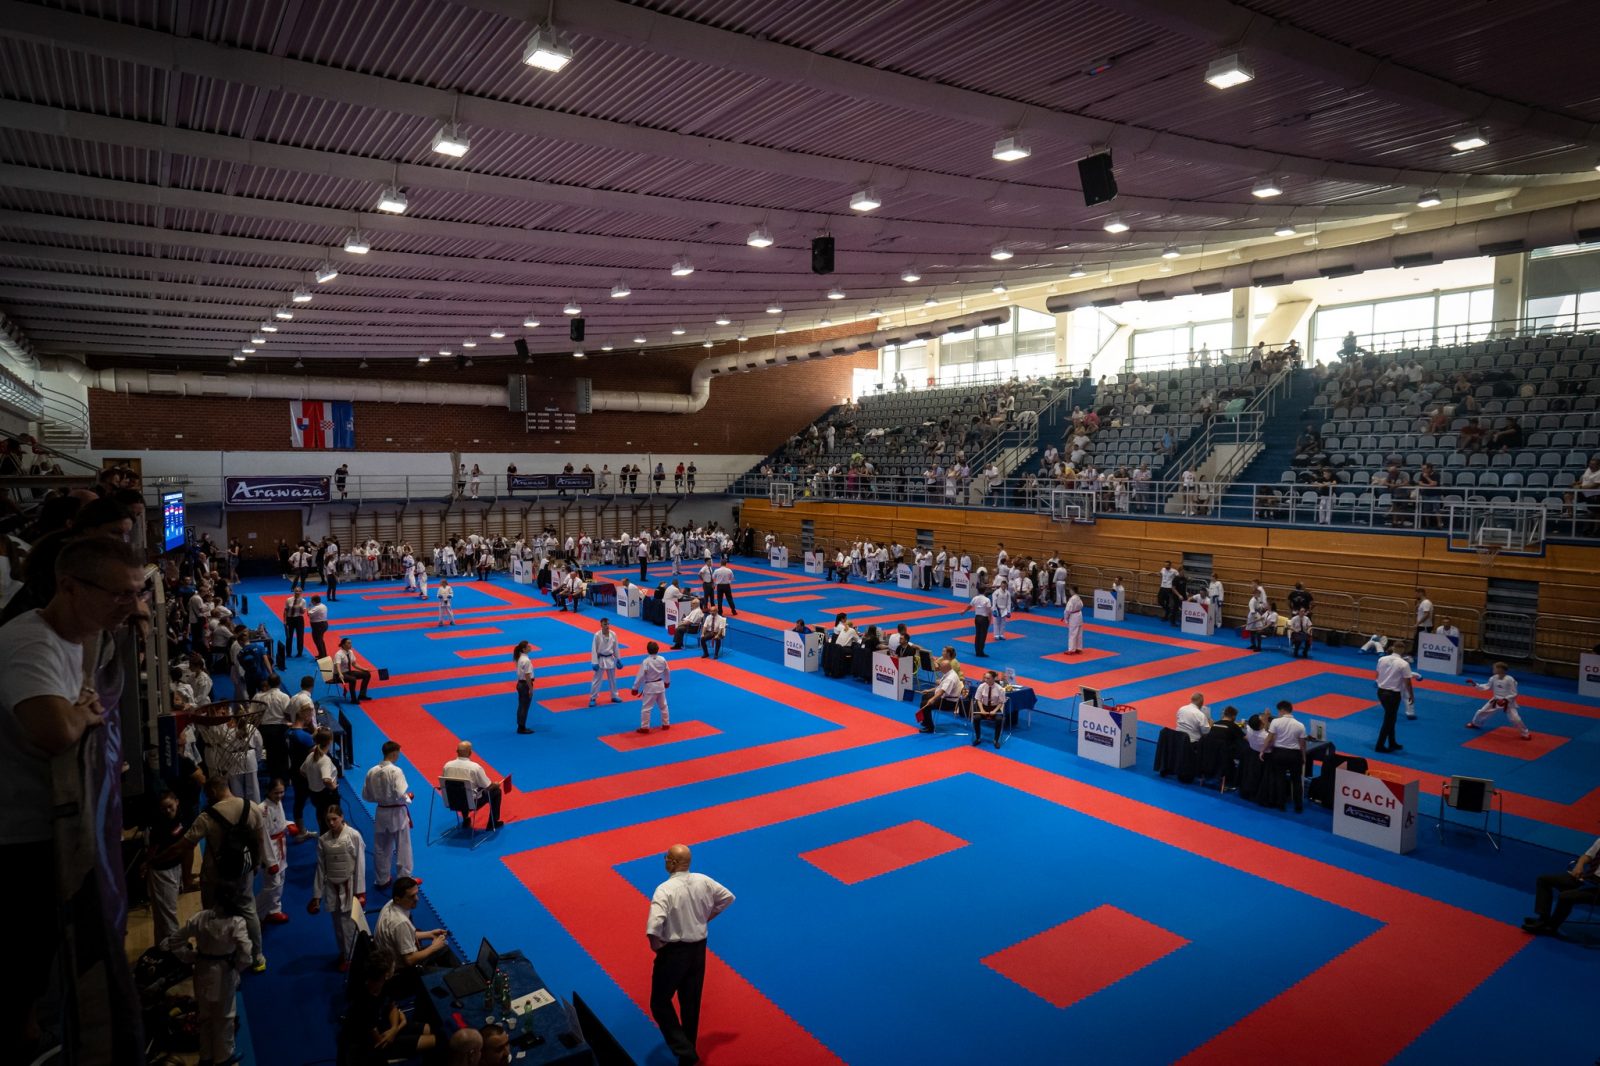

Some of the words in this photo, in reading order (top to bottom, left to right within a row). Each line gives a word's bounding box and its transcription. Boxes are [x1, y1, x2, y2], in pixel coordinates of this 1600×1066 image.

[232, 481, 326, 498] Arawaza
[786, 640, 803, 649] COACH
[1422, 643, 1454, 653] COACH
[875, 664, 896, 676] COACH
[1083, 720, 1116, 736] COACH
[1342, 786, 1395, 809] COACH
